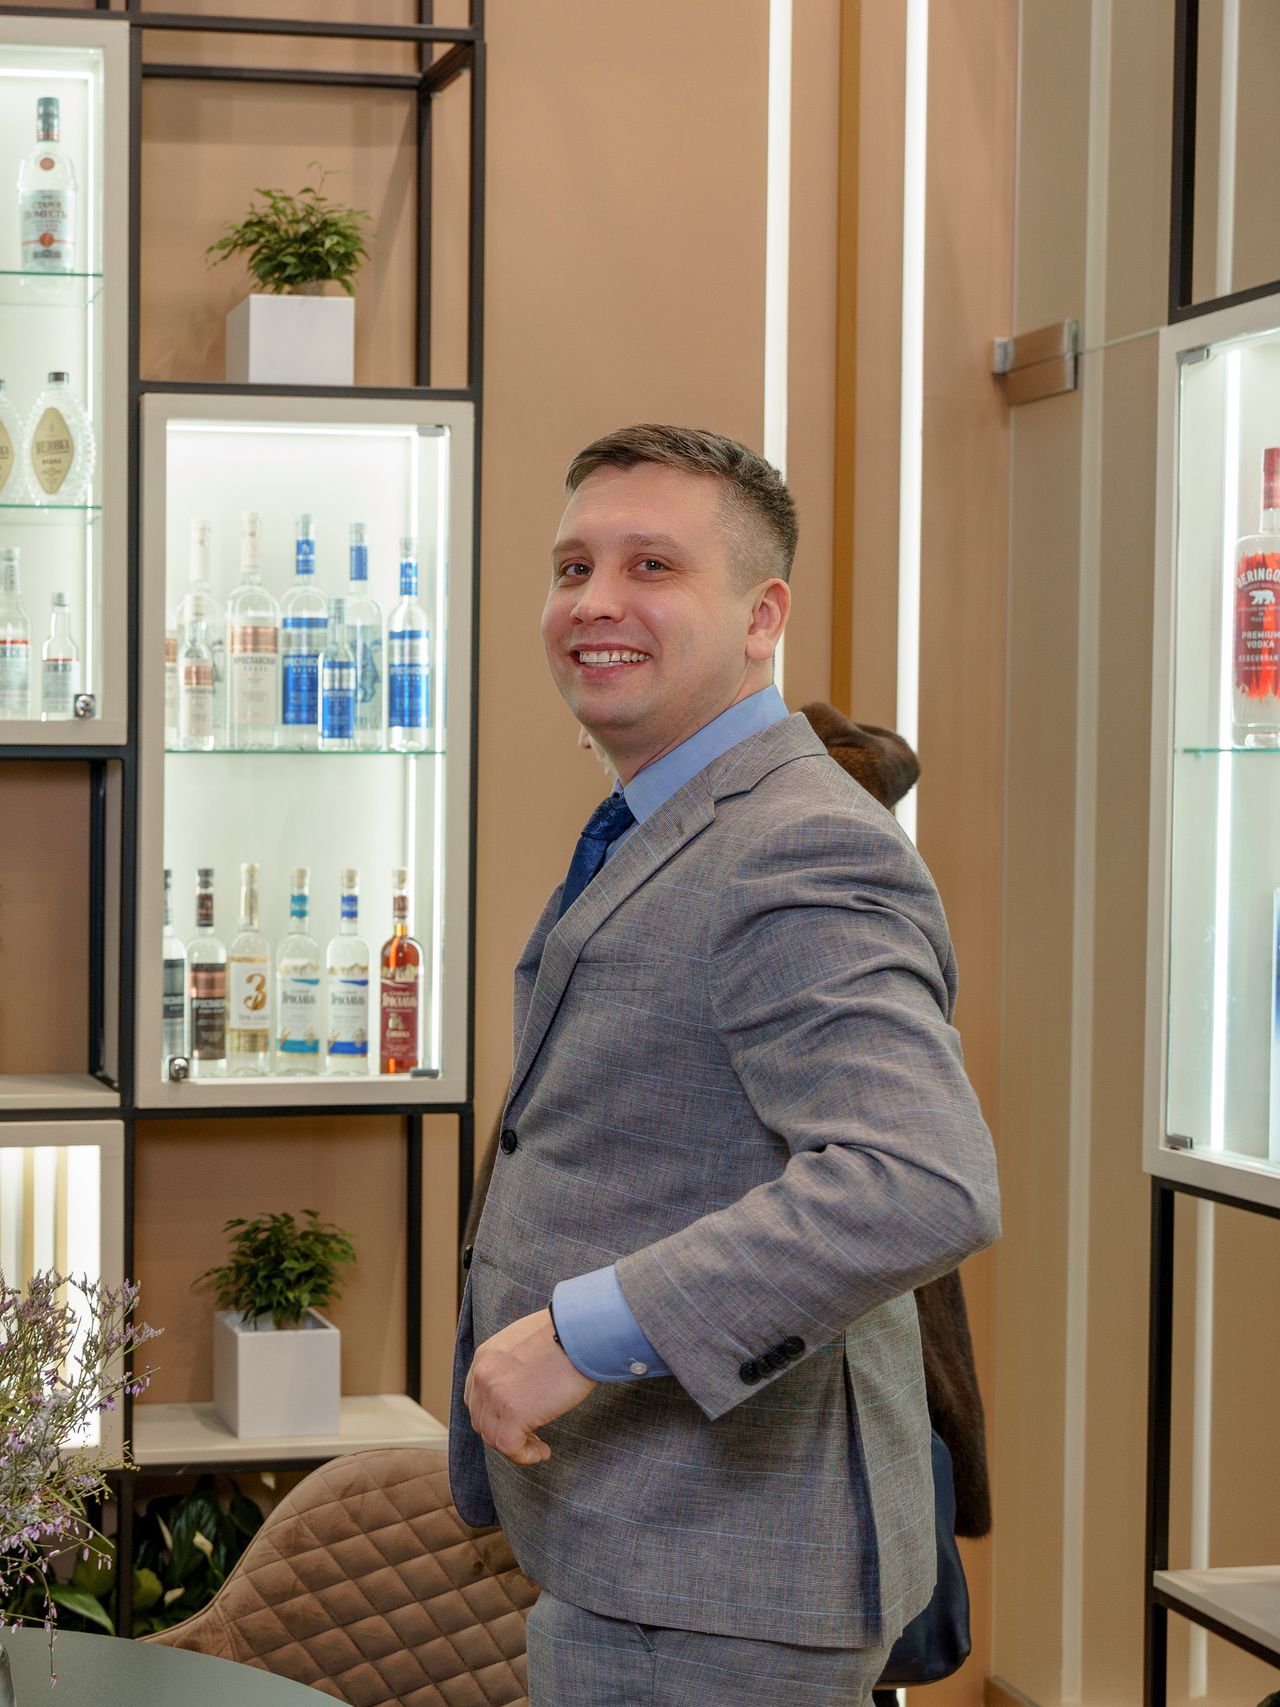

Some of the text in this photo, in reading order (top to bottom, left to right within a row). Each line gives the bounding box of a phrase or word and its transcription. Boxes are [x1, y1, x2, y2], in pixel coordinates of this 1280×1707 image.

[1241, 631, 1280, 640] PREMIUM
[1246, 640, 1275, 649] VODKA
[1238, 654, 1280, 662] REDCURRAN
